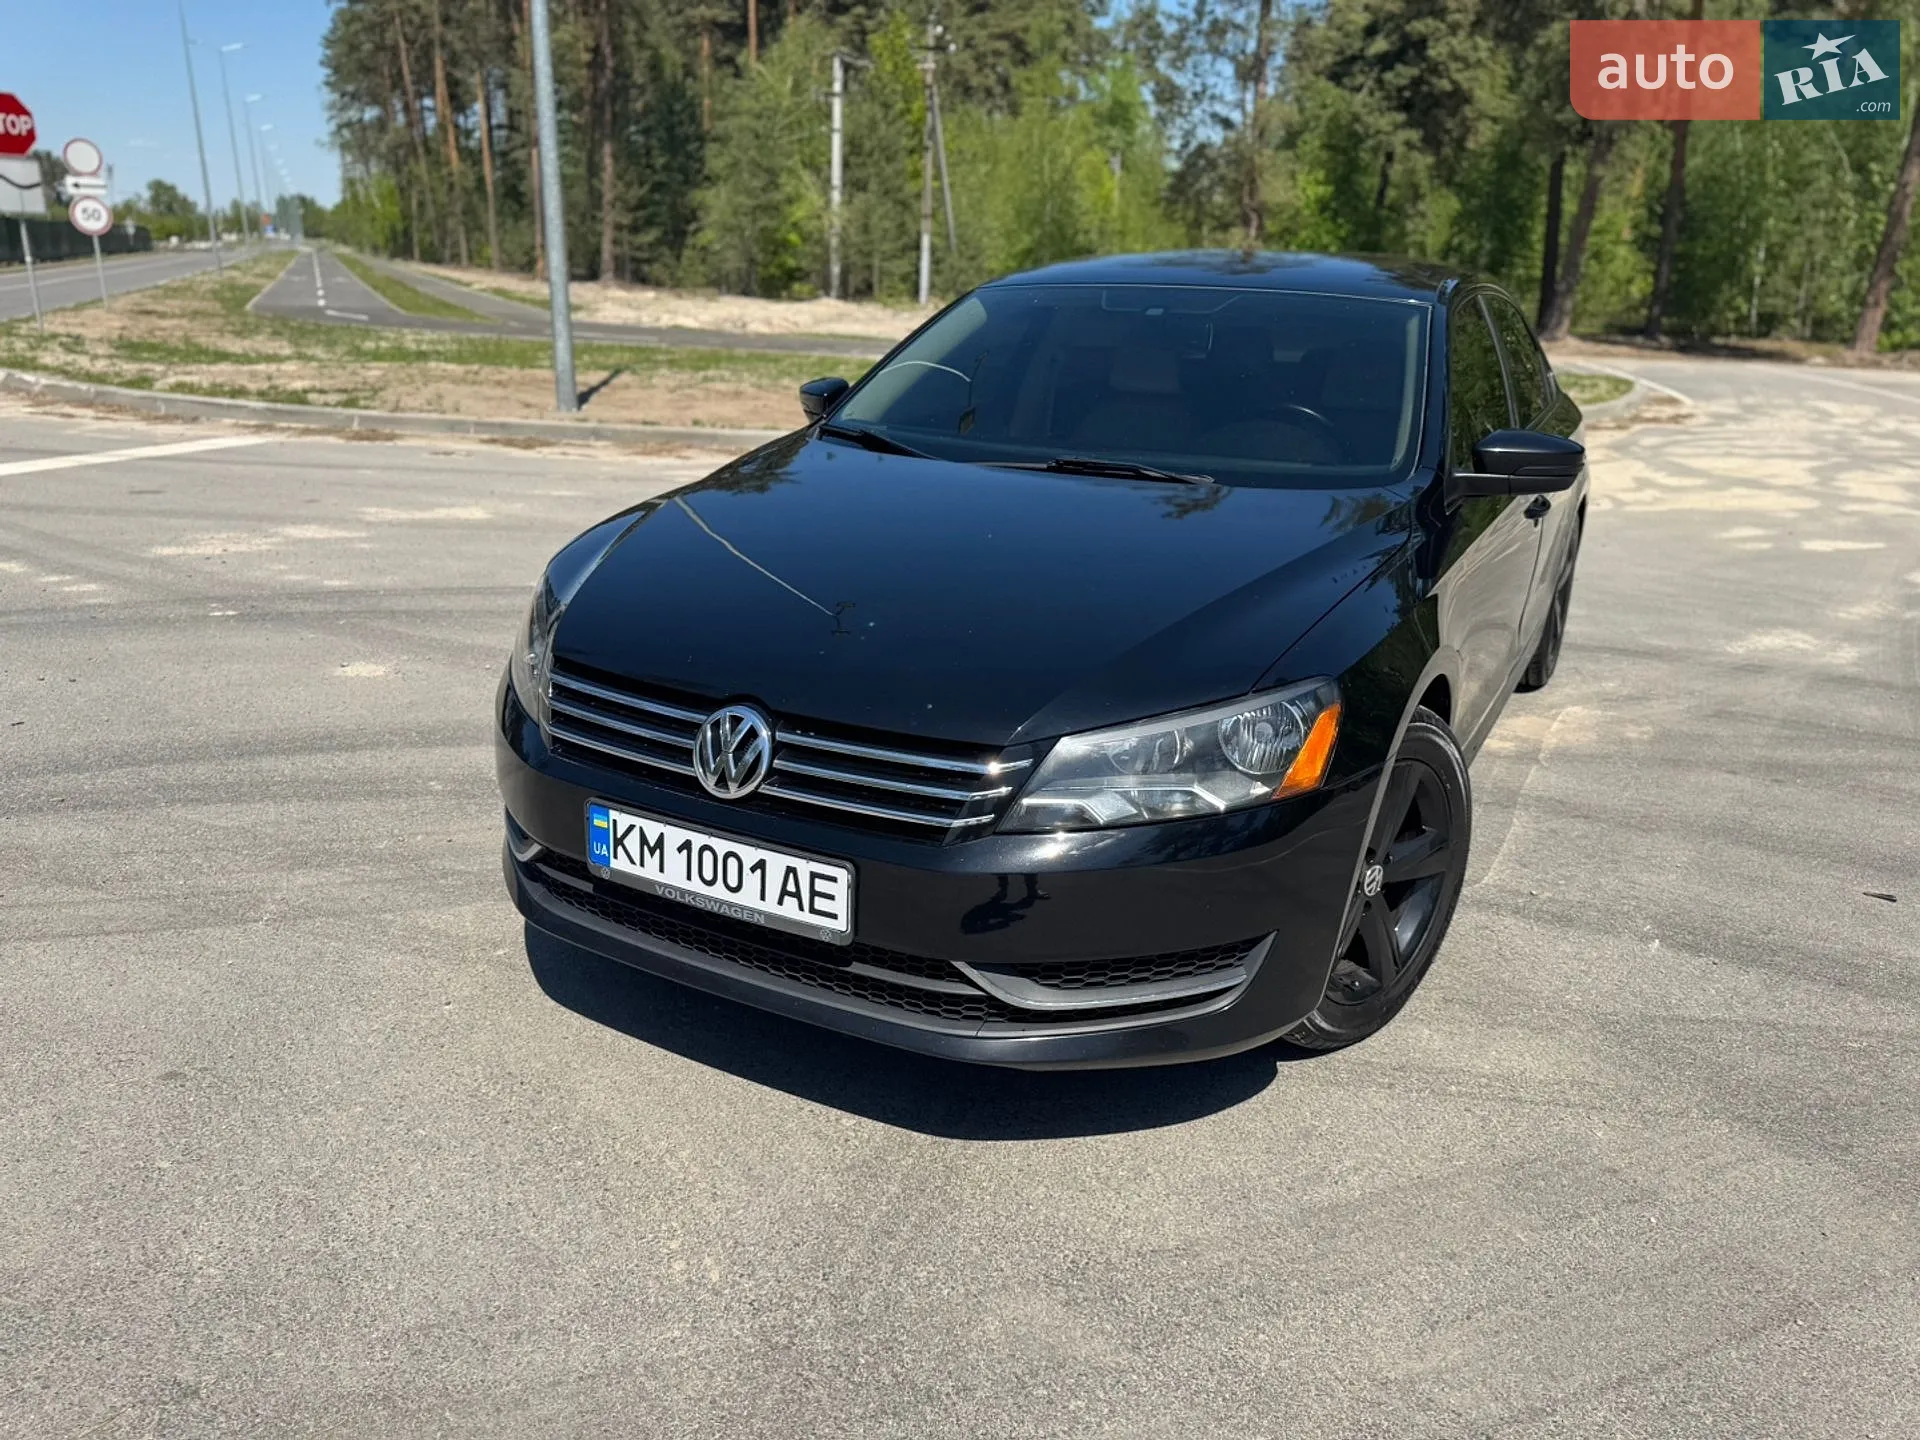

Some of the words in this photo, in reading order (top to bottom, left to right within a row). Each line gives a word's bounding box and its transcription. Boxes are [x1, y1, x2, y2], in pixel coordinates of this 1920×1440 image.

[81, 207, 101, 221] 50
[593, 841, 608, 857] UA
[612, 818, 665, 874] KM
[676, 838, 767, 902] 1001
[777, 865, 839, 920] AE
[654, 884, 766, 924] VOLKSWAGEN
